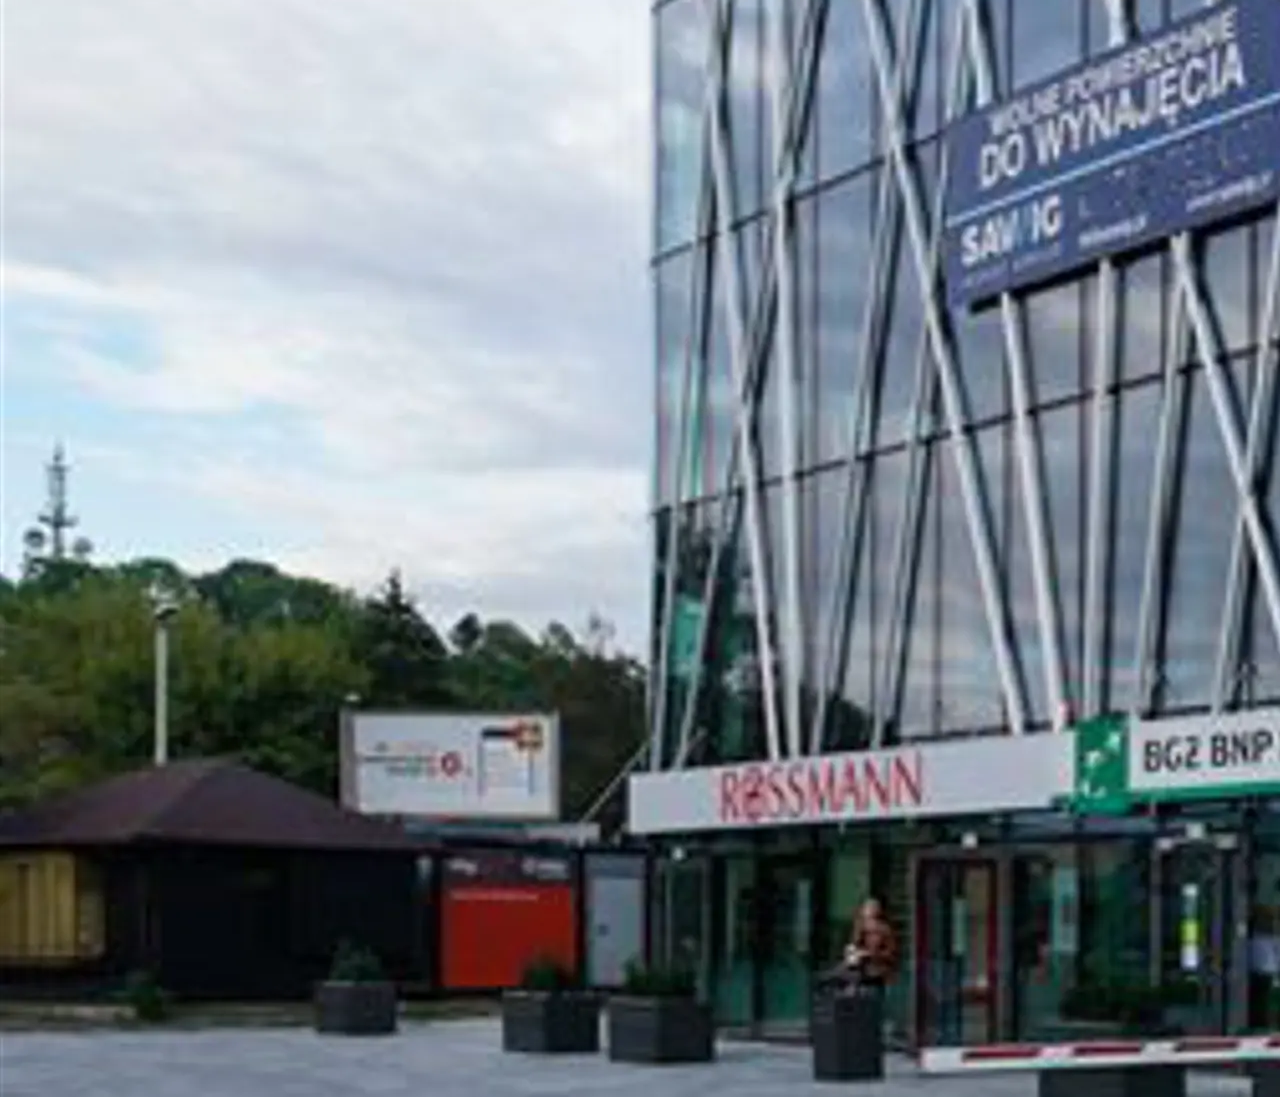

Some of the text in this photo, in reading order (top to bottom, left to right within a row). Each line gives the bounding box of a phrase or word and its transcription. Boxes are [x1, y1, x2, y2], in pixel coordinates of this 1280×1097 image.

[980, 133, 1025, 190] DO
[1036, 43, 1246, 165] WYNAJĘCIA
[1209, 729, 1274, 767] BNP
[720, 749, 923, 824] ROSSMANN
